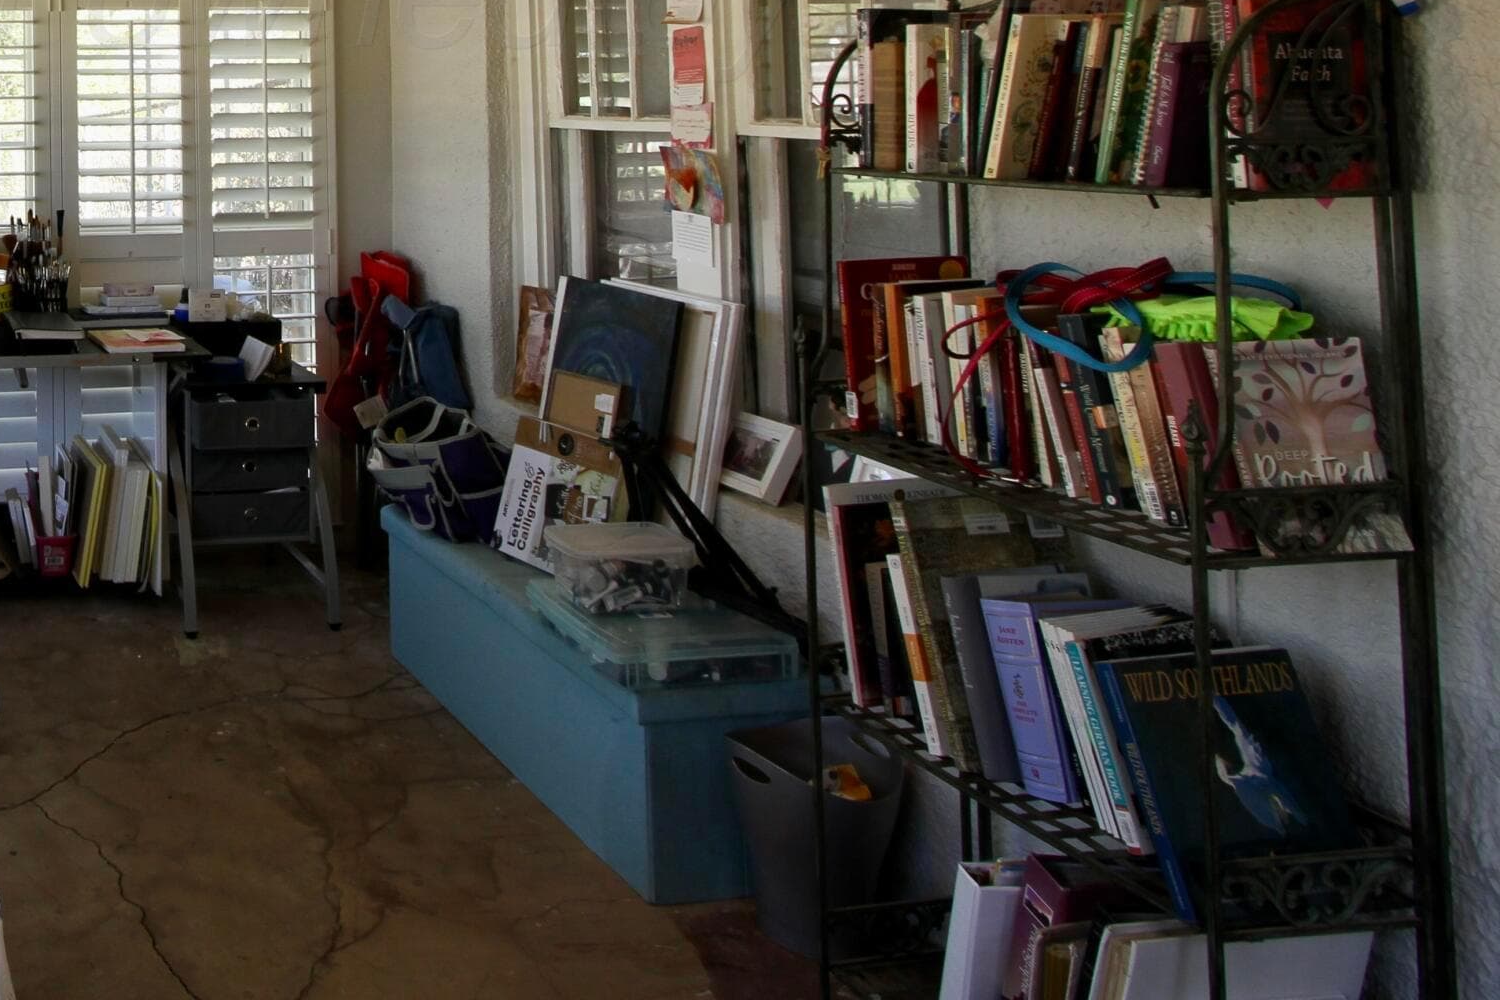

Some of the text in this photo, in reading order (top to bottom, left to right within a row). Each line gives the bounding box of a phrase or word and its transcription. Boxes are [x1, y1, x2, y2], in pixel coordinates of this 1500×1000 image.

[1121, 20, 1132, 42] YEAR
[1119, 43, 1128, 54] IN
[1275, 43, 1344, 60] Abueita
[1116, 58, 1125, 71] THE
[1110, 72, 1123, 111] COUNTRY
[1020, 353, 1029, 393] DAUGHTER
[1165, 415, 1181, 447] BREAKER
[1276, 450, 1309, 461] DEEP
[517, 467, 546, 551] Calligraphy
[856, 493, 892, 503] THOMAS
[507, 480, 533, 547] Lettering
[997, 635, 1025, 646] AUSTEN
[999, 626, 1016, 635] JANE
[1124, 662, 1294, 703] WILD SOTHLANDS
[1072, 659, 1122, 800] LEARNING GERMAN BOOK
